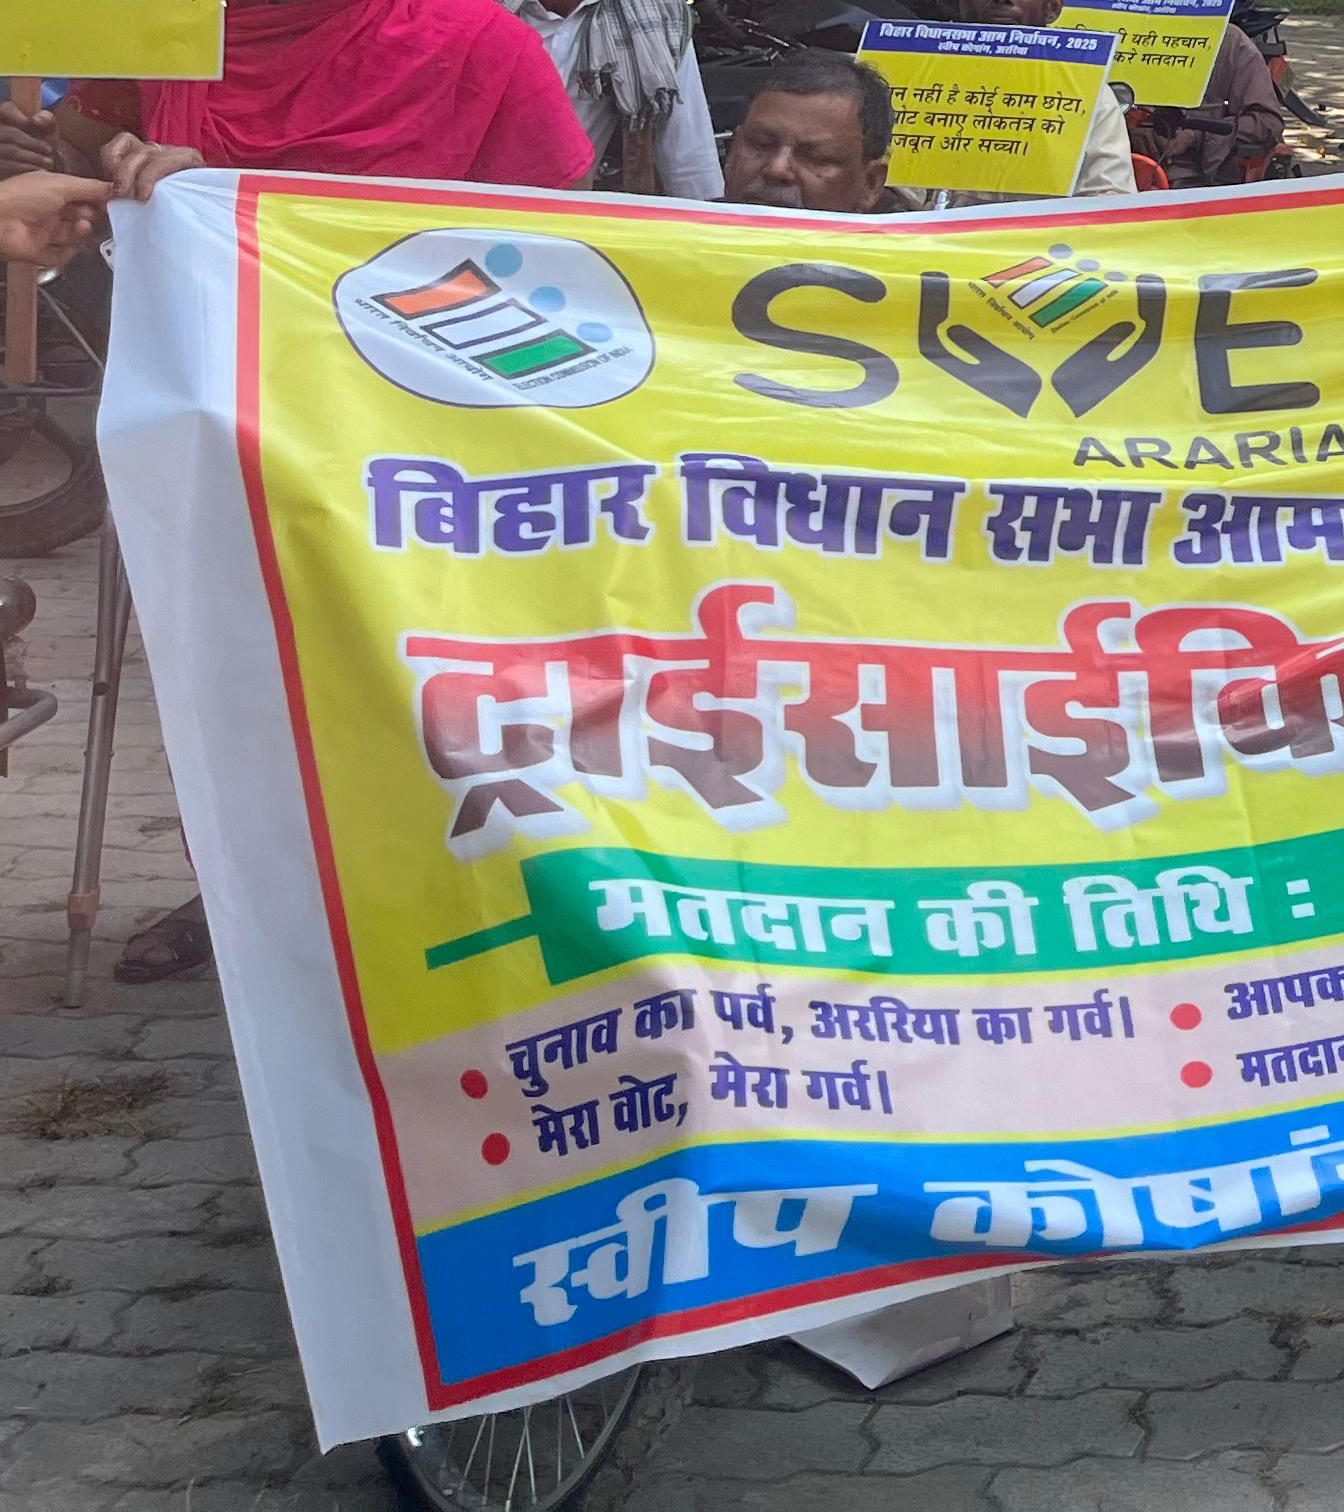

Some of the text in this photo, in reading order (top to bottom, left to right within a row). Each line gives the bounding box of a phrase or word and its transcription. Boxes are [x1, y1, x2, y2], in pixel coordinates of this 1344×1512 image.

[1132, 30, 1158, 48] यही
[912, 84, 944, 105] नहीं
[946, 83, 961, 105] है
[964, 85, 1001, 108] कोई
[1001, 92, 1038, 110] काम
[923, 108, 1067, 137] बनाए लोकतंत्र को
[940, 129, 971, 150] और
[367, 458, 657, 555] बिहार
[682, 453, 966, 559] विधान
[986, 481, 1159, 567] सभा
[589, 878, 894, 958] मतदान
[918, 879, 1040, 958] की
[1062, 866, 1254, 953] तिथि
[506, 983, 1135, 1098] चुनाव का पर्व, अररिया का गर्व।
[532, 1051, 895, 1156] मेरा वोट, मेरा गर्व।
[511, 1178, 879, 1328] स्वीप
